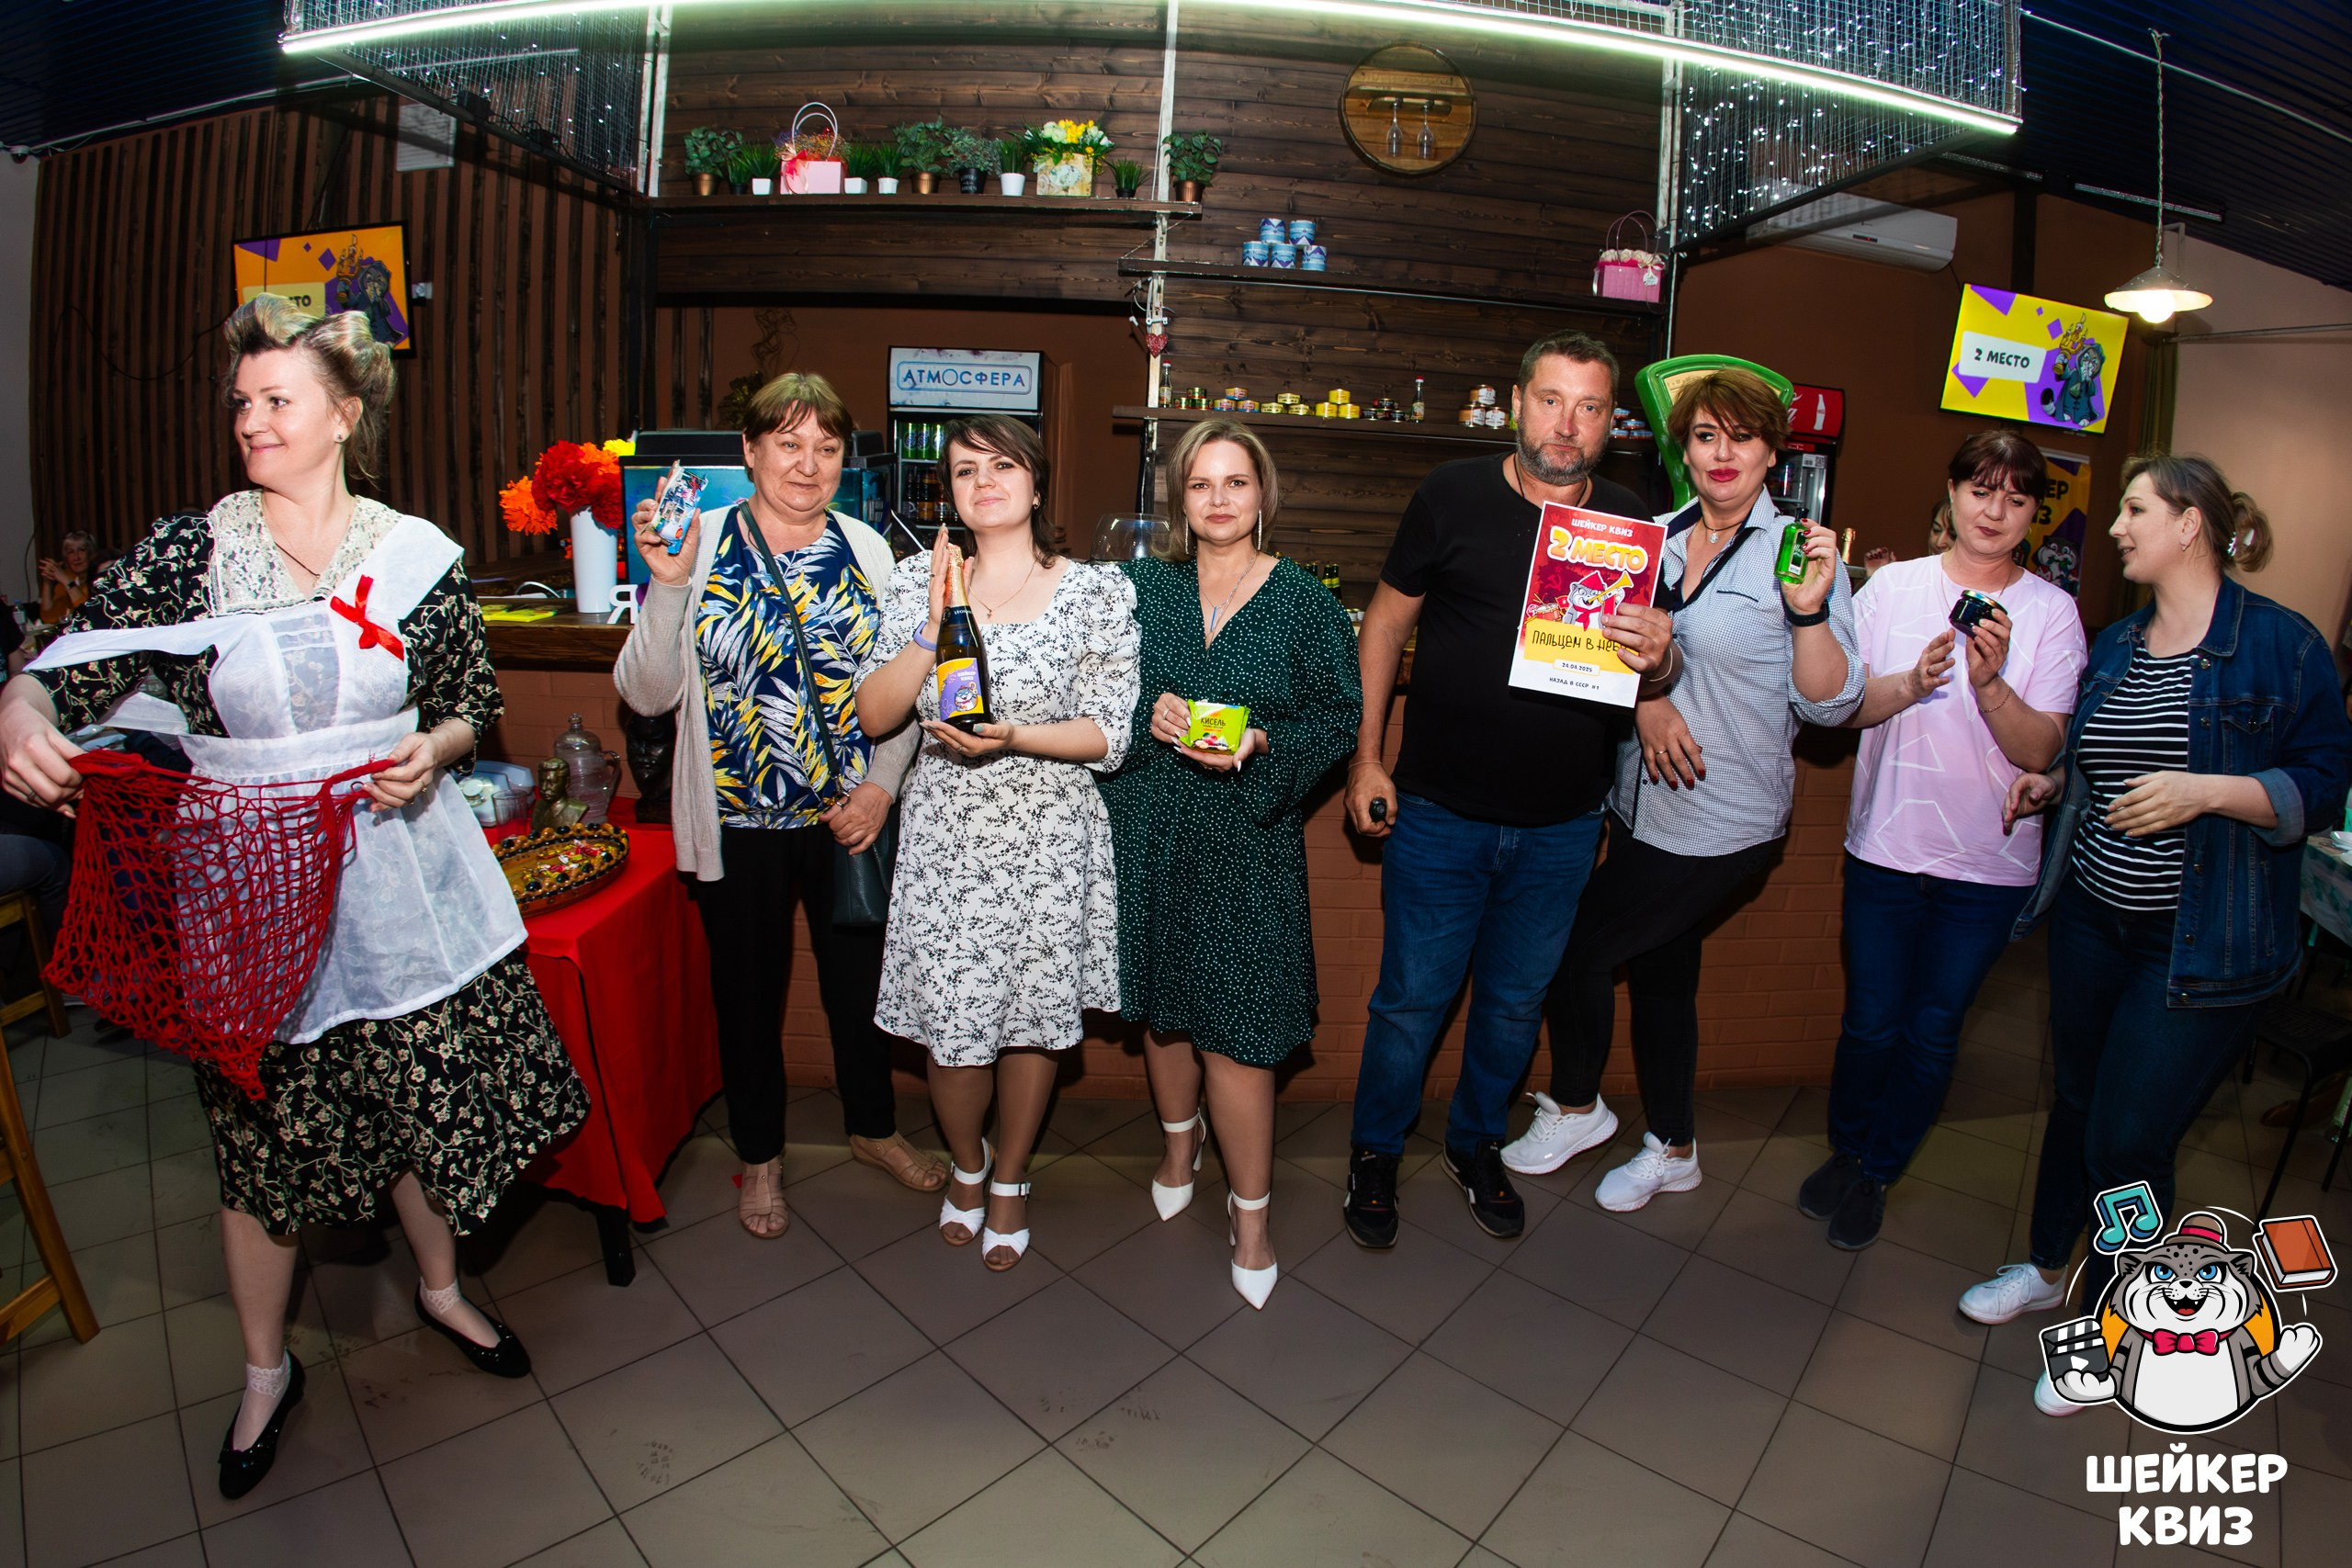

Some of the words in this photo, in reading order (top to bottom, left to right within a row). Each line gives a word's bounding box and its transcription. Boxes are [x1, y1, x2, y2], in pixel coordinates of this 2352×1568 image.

[1974, 348, 1983, 361] 2
[1986, 351, 2030, 368] МЕСТО
[903, 368, 1025, 388] АТМОСФЕРА
[1571, 519, 1607, 532] ШЕЙКЕР
[1609, 526, 1633, 536] КВИЗ
[1549, 527, 1570, 559] 2
[1569, 536, 1646, 571] МЕСТО
[1597, 638, 1627, 652] НЕБ
[1562, 662, 1592, 672] 24.04.2025
[1549, 677, 1568, 685] НАЗАД
[1201, 717, 1227, 727] КИСЕЛЬ
